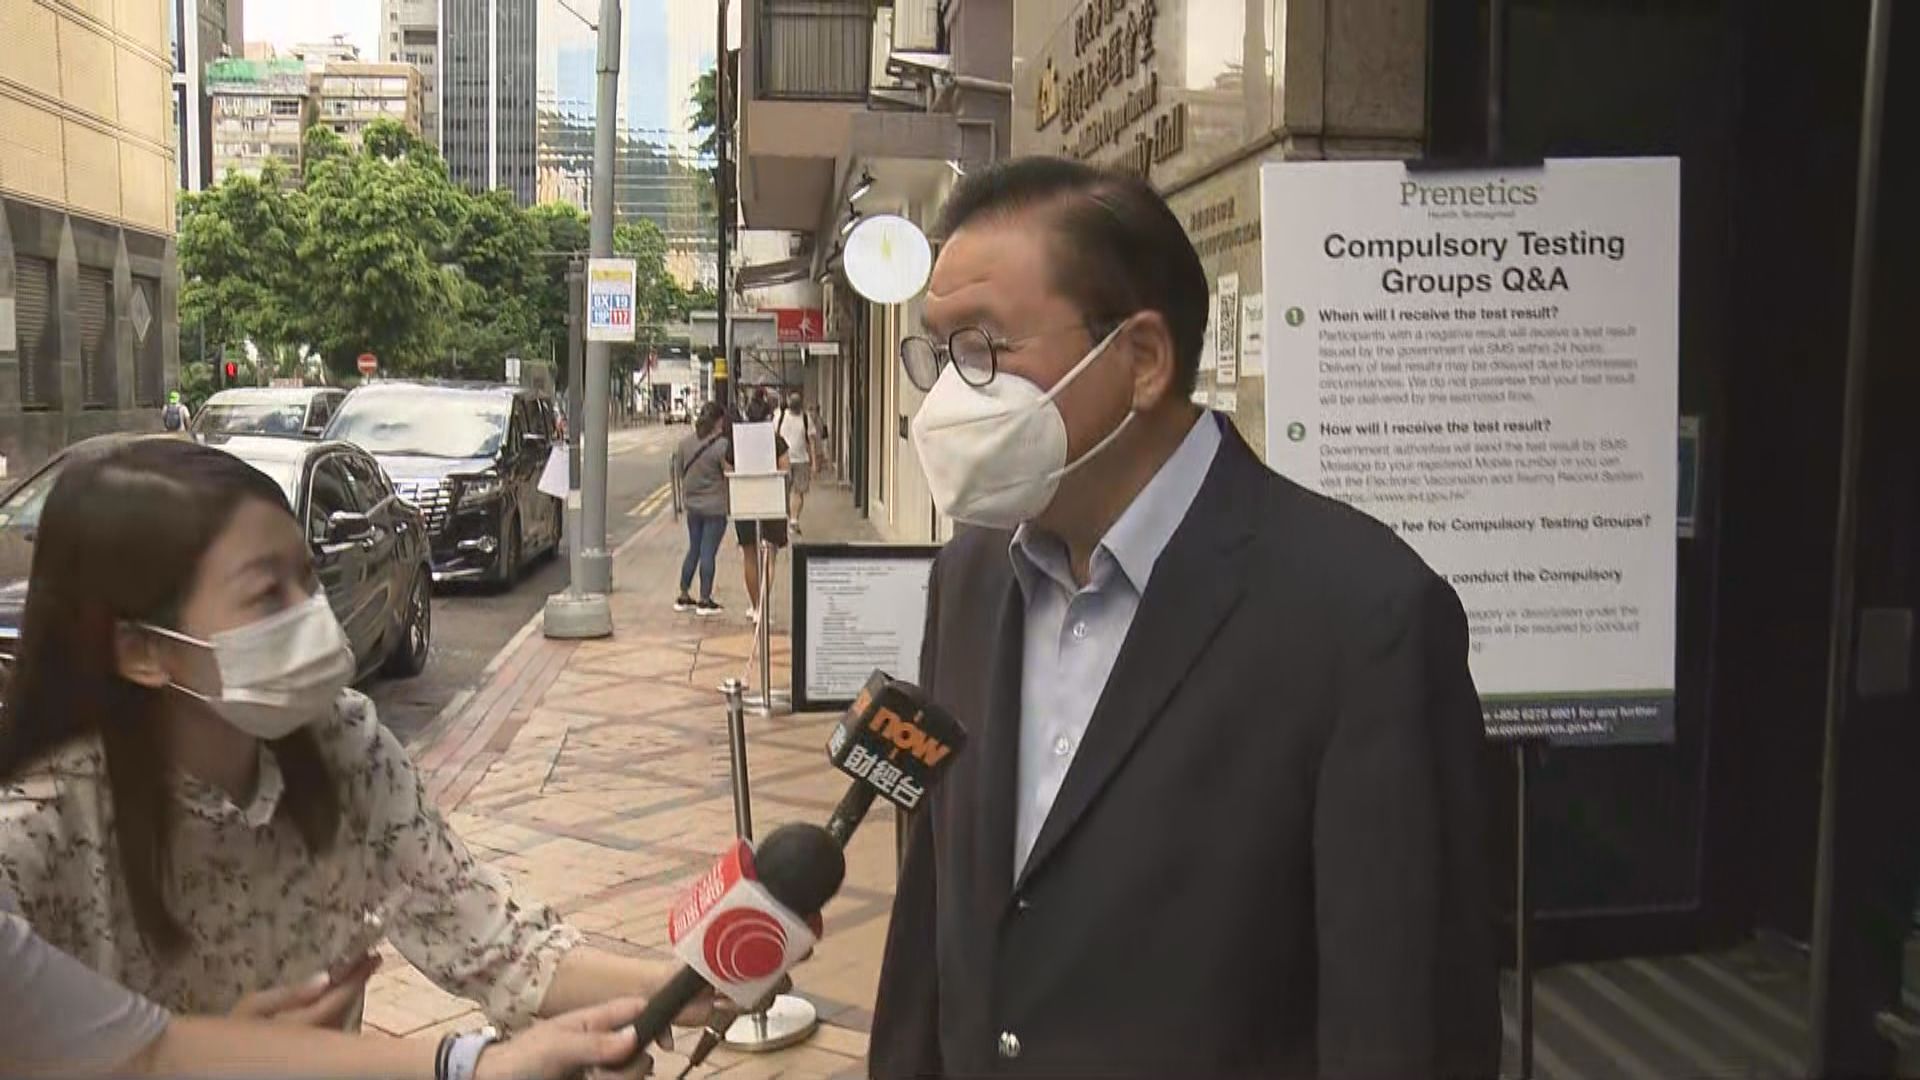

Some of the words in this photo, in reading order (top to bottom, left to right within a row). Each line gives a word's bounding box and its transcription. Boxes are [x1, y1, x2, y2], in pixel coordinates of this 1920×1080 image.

[1400, 177, 1537, 205] Prenetics
[1324, 232, 1507, 261] Compulsory
[1518, 230, 1626, 259] Testing
[1382, 268, 1492, 297] Groups
[1502, 266, 1569, 293] Q&A
[1319, 310, 1359, 322] When
[1363, 309, 1387, 321] will
[1391, 309, 1395, 321] I
[1400, 308, 1450, 321] receive
[1455, 308, 1476, 319] the
[1481, 307, 1507, 319] test
[1511, 306, 1559, 319] result?
[1320, 423, 1351, 435] How
[1356, 422, 1379, 434] will
[1384, 422, 1388, 433] I
[1392, 422, 1443, 433] receive
[1448, 421, 1468, 432] the
[1473, 421, 1500, 432] test
[1504, 419, 1551, 432] result?
[1402, 520, 1424, 532] fee
[1428, 519, 1446, 531] for
[1452, 518, 1535, 532] Compulsory
[1540, 516, 1588, 529] Testing
[1593, 514, 1651, 529] Groups?
[1453, 571, 1509, 584] conduct
[1513, 570, 1535, 582] the
[1539, 569, 1623, 584] Compulsory
[869, 707, 951, 766] now
[843, 744, 924, 808] 財經台
